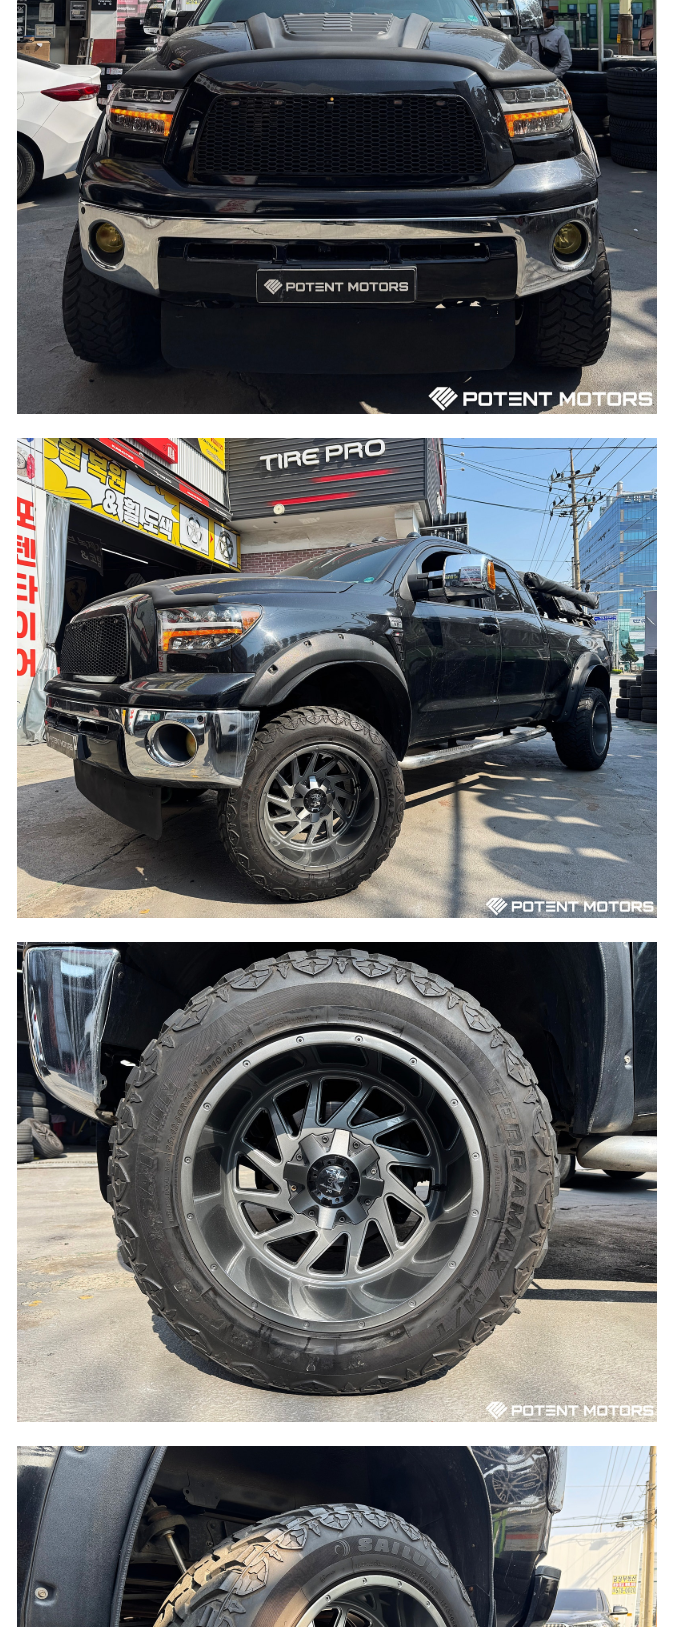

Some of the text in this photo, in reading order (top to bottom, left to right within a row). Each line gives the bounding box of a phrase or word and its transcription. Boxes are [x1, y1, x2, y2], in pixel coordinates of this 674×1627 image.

[285, 282, 409, 292] POTENT MOTORS
[259, 438, 386, 472] TIRE PRO
[102, 488, 174, 542] & 휠 도색
